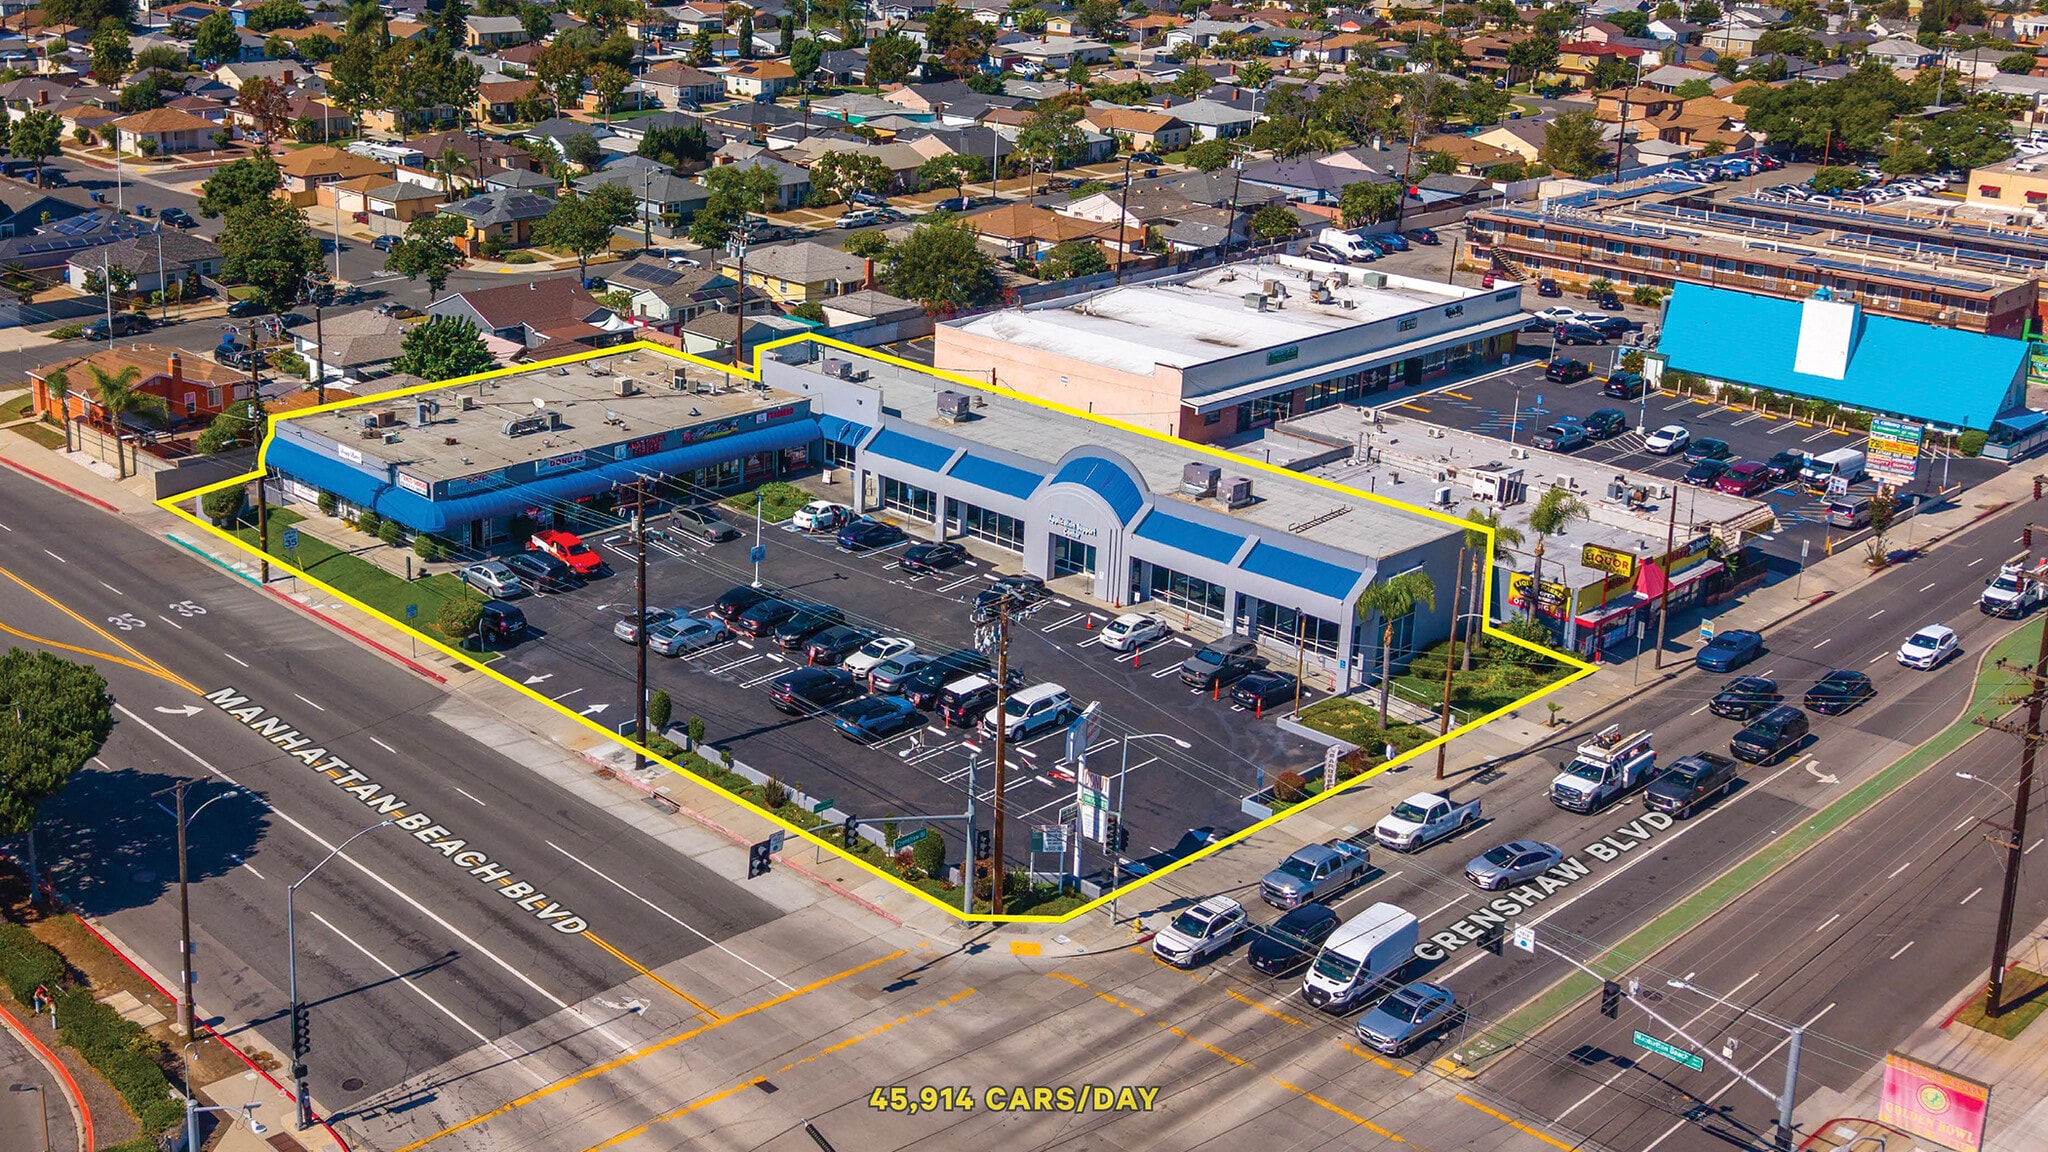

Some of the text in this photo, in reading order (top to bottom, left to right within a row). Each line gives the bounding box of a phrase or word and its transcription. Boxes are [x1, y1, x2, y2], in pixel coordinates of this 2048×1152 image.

[550, 454, 584, 467] DONUTS
[1585, 552, 1629, 571] LIQUOR
[169, 600, 207, 617] 35
[107, 612, 147, 631] 35
[1885, 1101, 1975, 1143] GOLDEN BOWL
